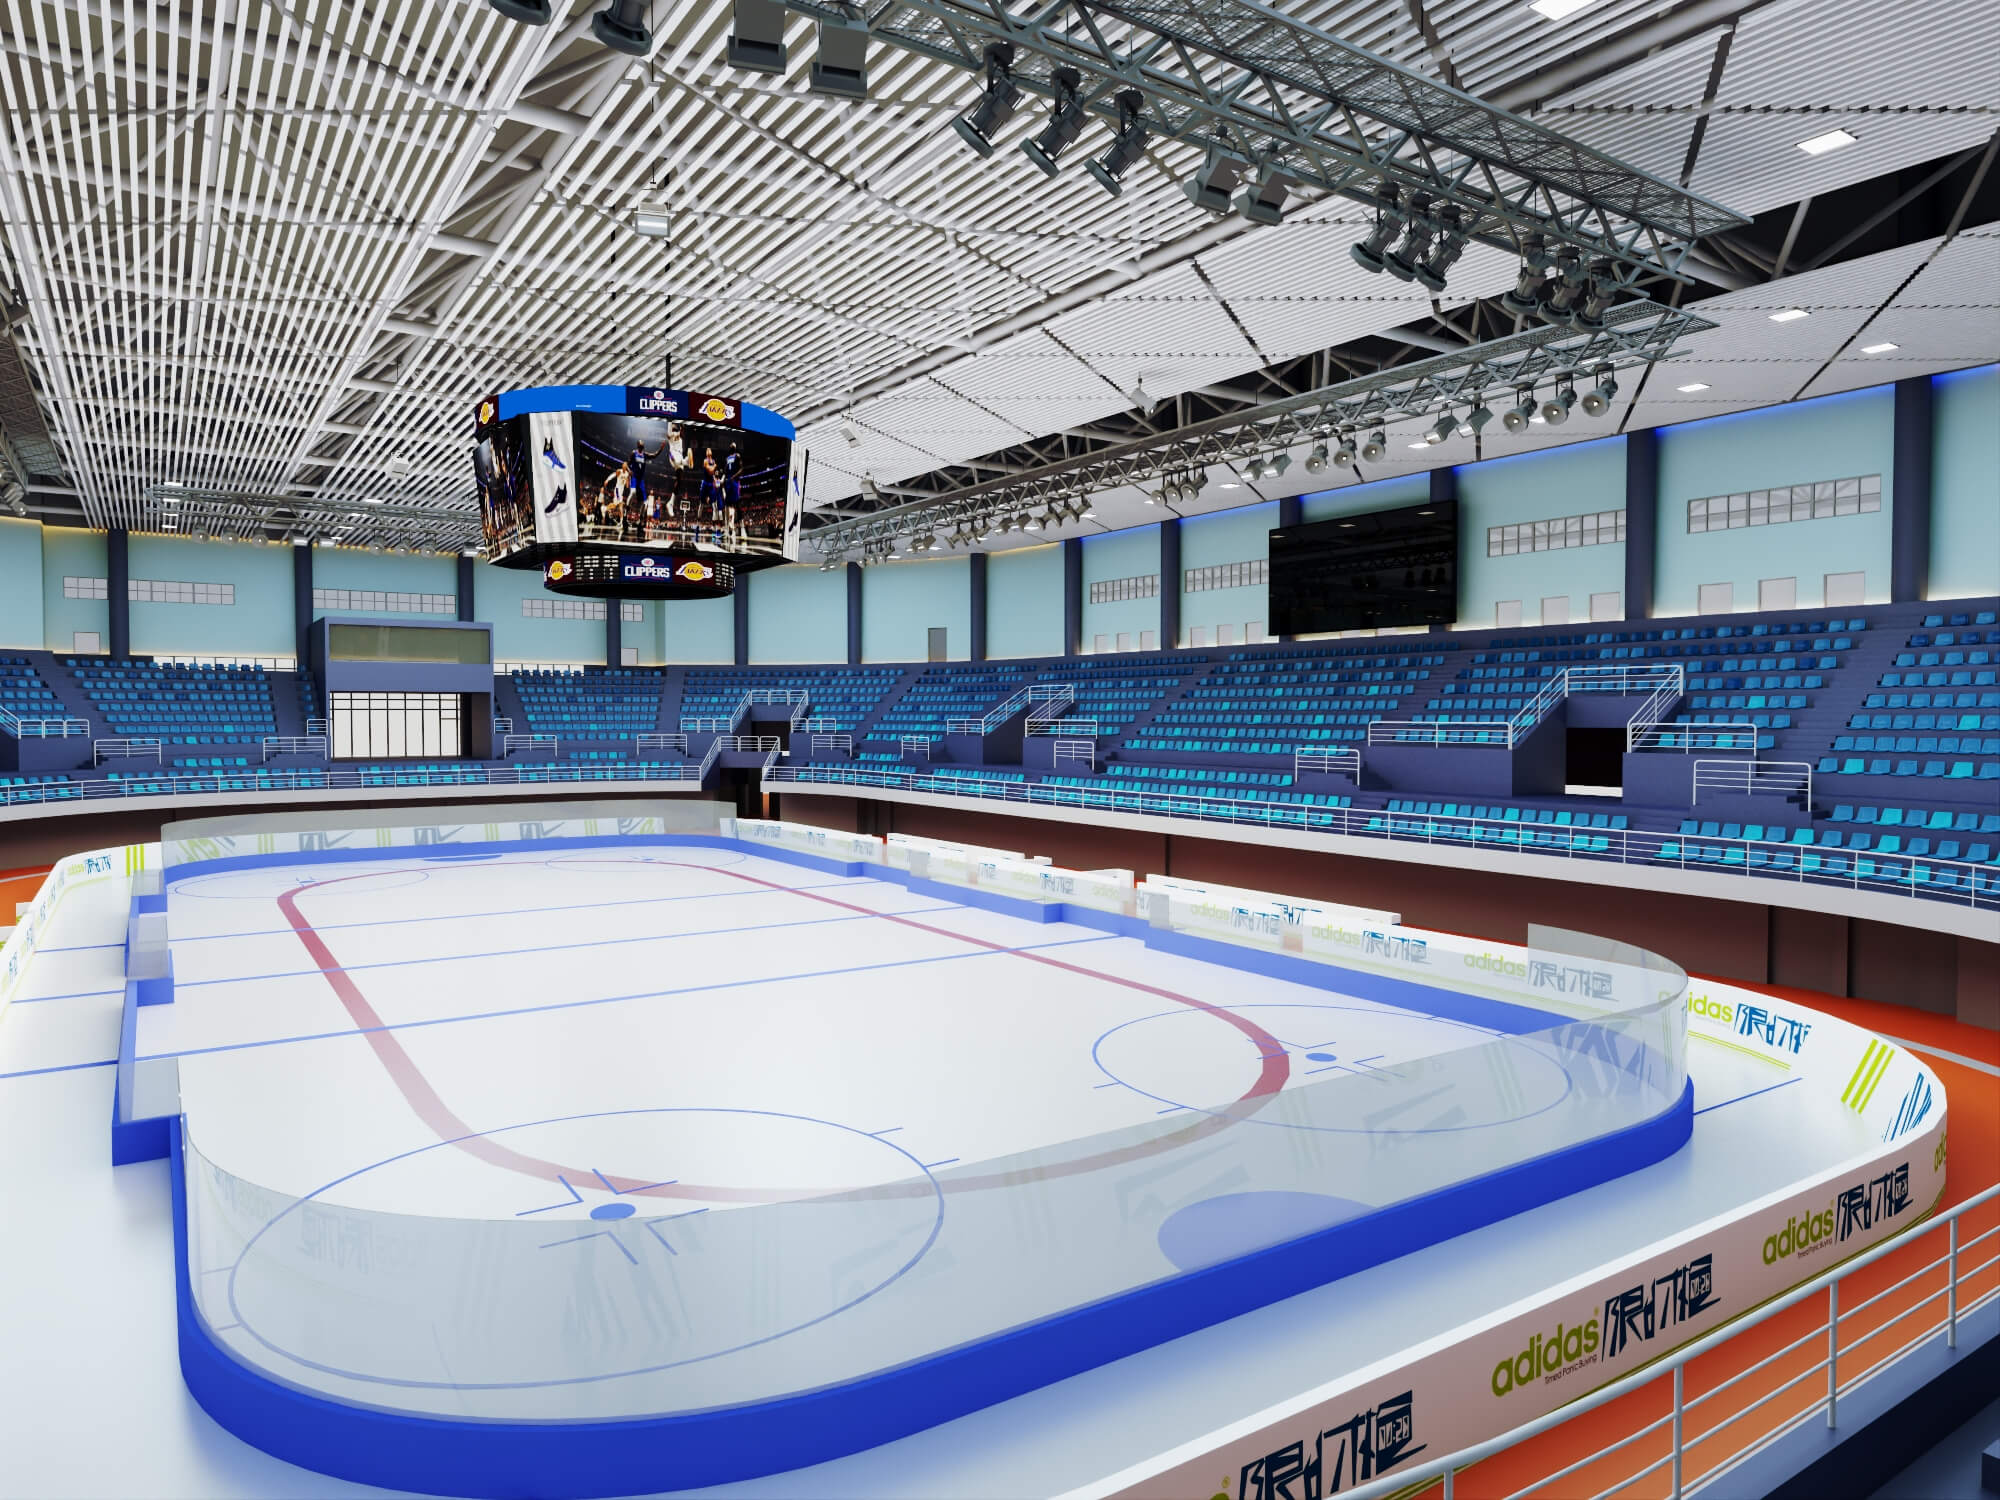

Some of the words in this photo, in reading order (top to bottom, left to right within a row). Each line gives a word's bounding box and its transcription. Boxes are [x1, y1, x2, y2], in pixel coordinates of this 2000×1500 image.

[640, 398, 678, 413] CLIPPERS
[624, 566, 670, 578] CLIPPERS
[1312, 924, 1360, 945] adidas
[1464, 952, 1526, 978] adidas
[1763, 1209, 1834, 1265] adidas
[1492, 1319, 1599, 1397] adidas
